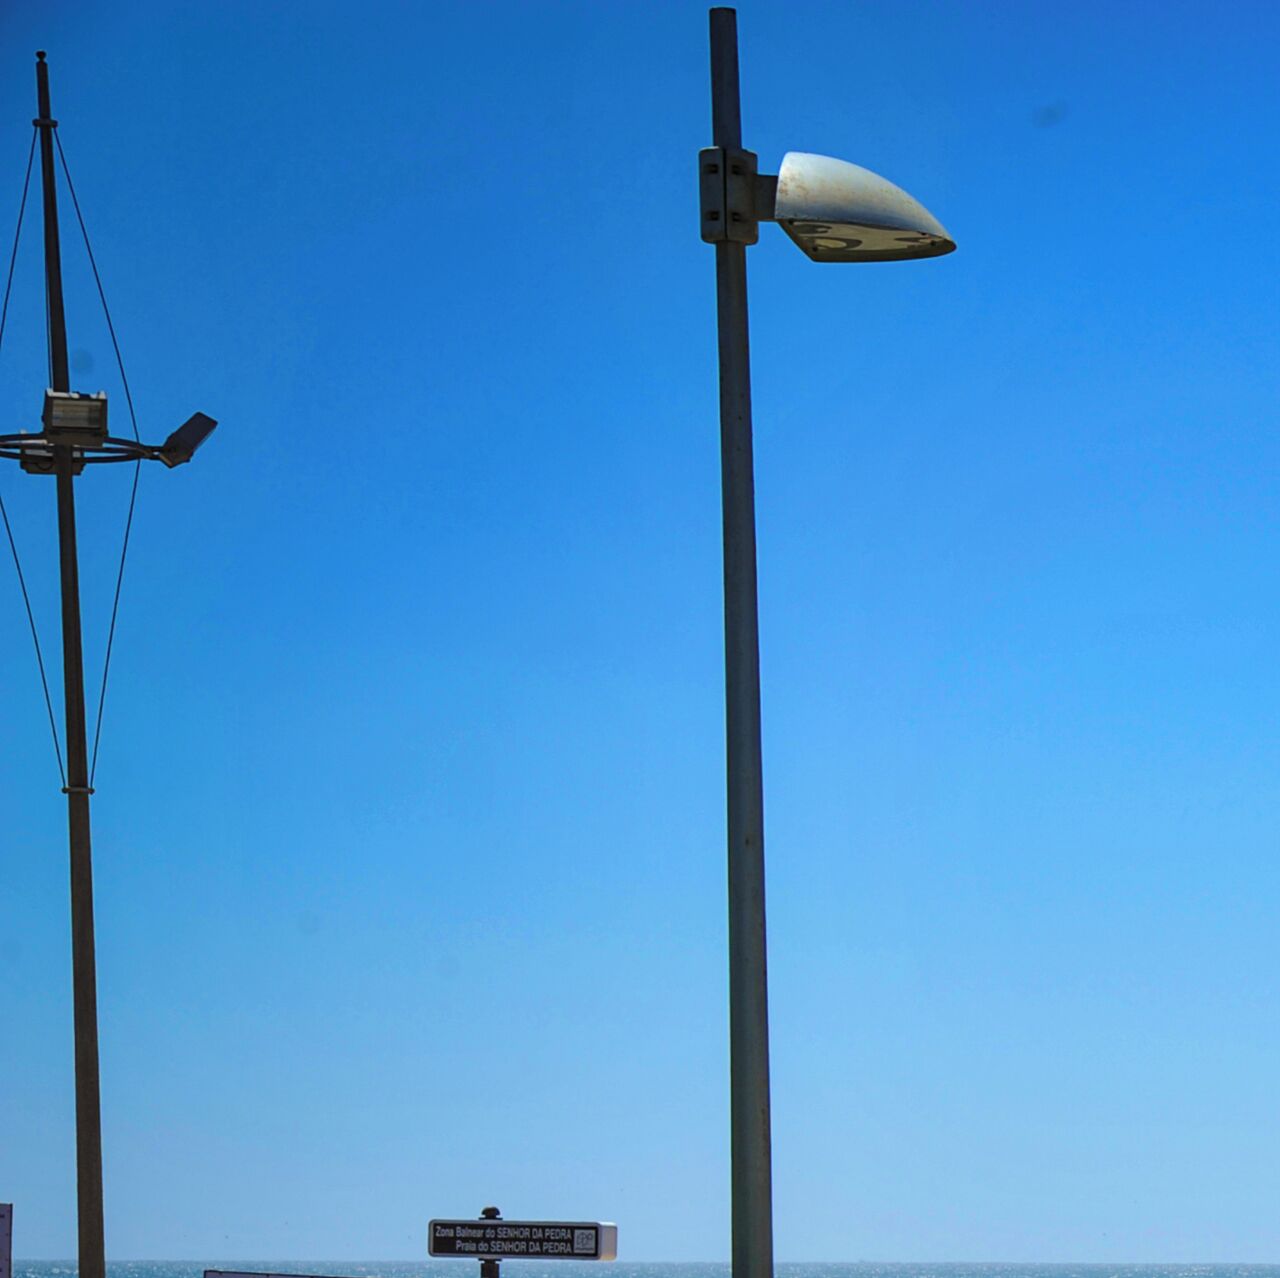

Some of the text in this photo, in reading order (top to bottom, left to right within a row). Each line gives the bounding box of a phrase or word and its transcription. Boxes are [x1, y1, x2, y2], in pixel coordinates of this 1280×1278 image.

[435, 1226, 572, 1240] Zona Balnear do SENHOR DA PEDRA
[456, 1240, 572, 1253] Praia do SENHOR DA PEDRA
